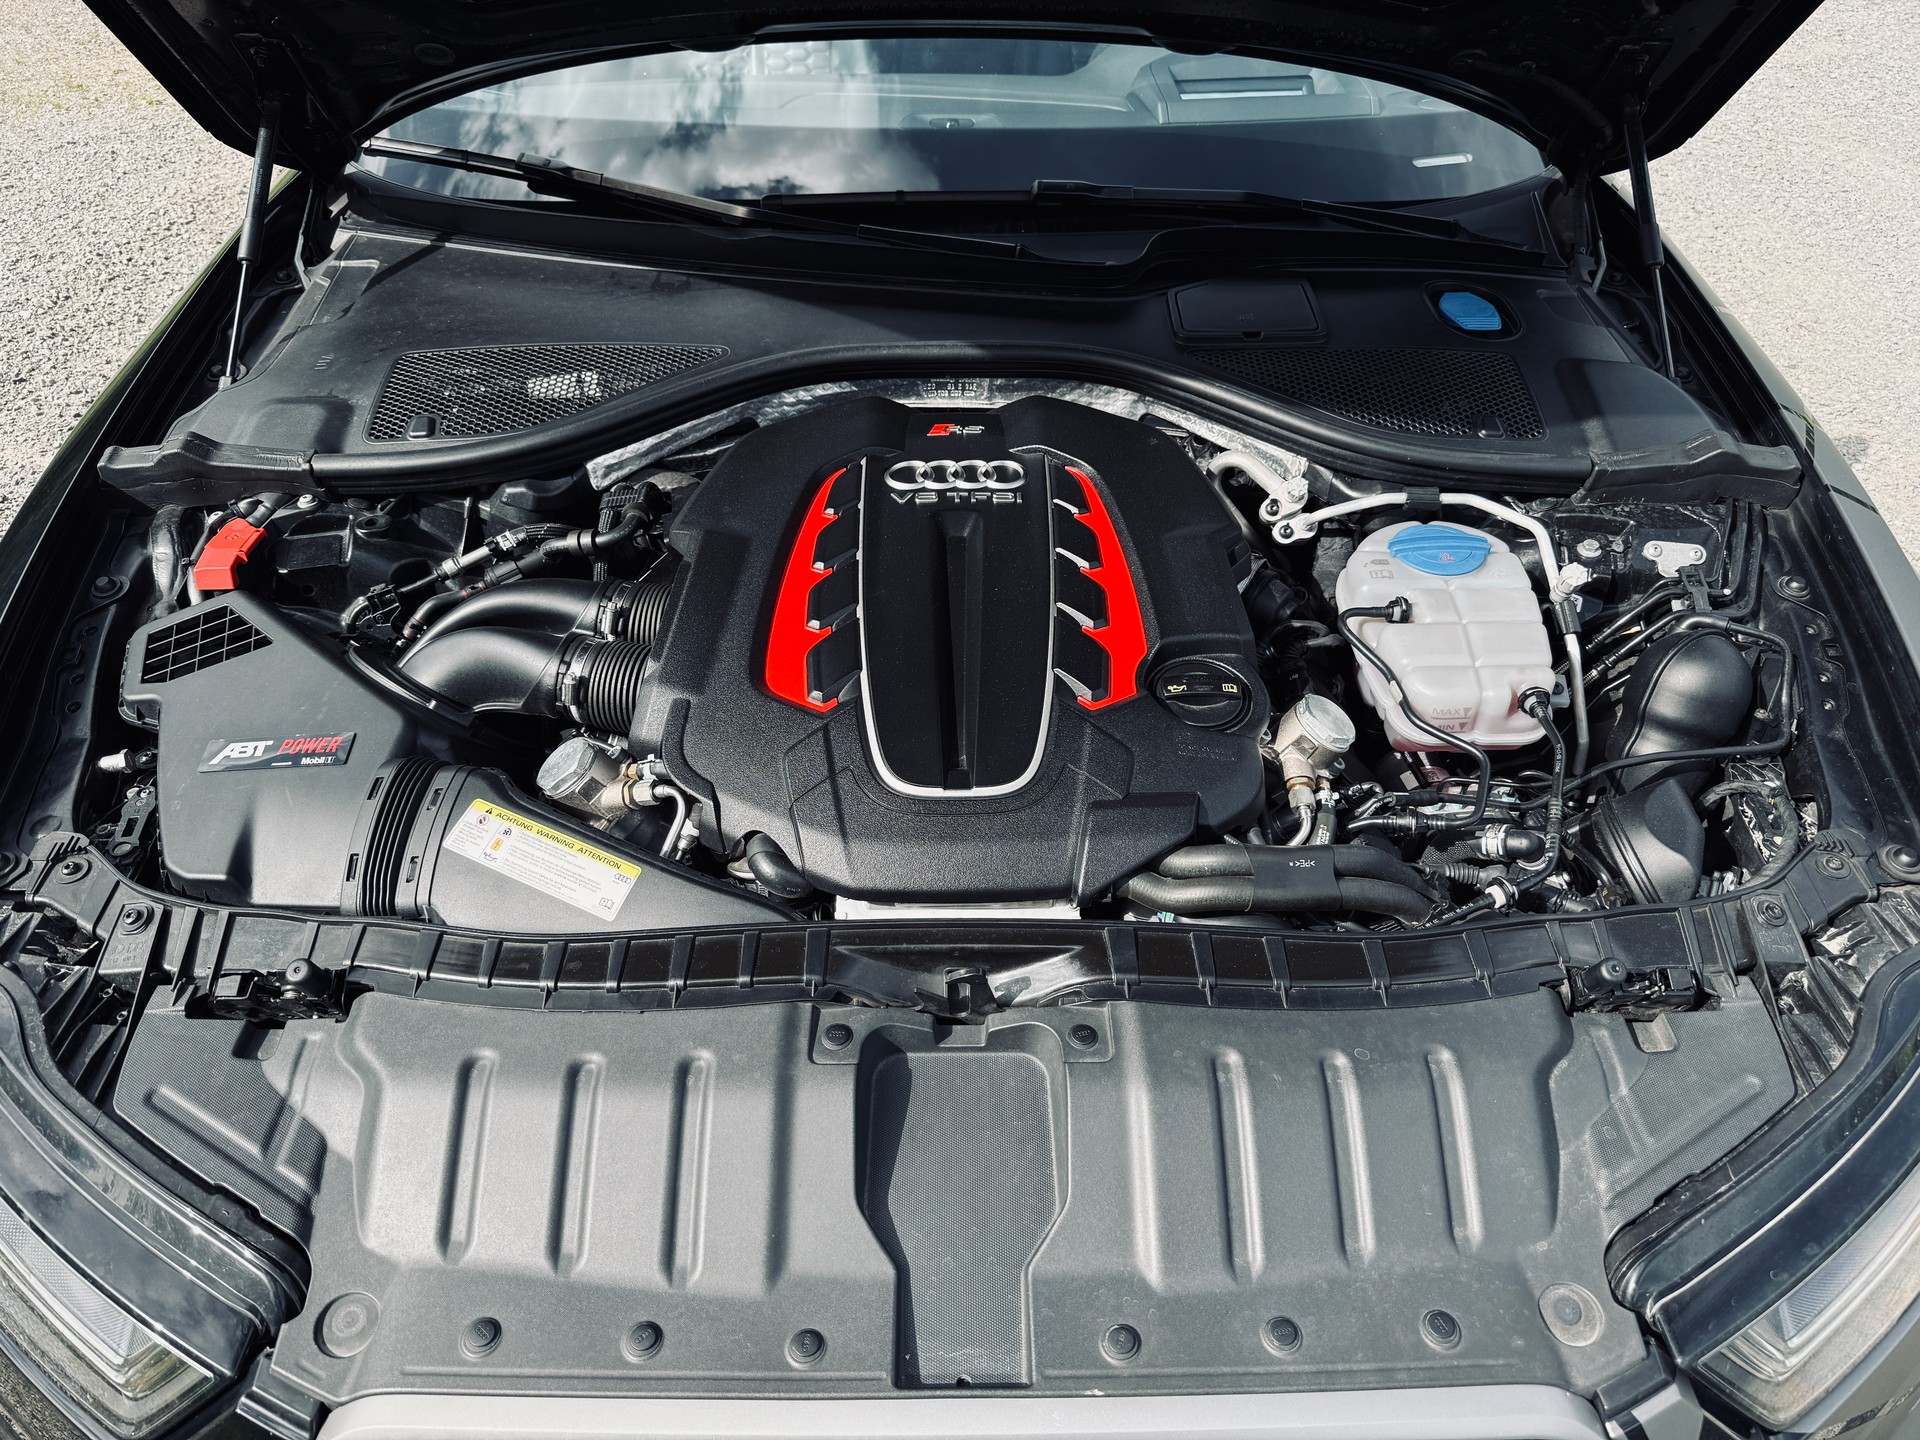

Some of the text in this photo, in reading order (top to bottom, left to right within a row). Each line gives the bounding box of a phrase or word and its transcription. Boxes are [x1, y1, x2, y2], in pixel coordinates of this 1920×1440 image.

[890, 491, 1023, 504] V8 TFSI
[208, 736, 343, 765] ABT POWER
[301, 757, 324, 765] Mobil
[495, 812, 533, 832] ACHTUNG
[536, 828, 575, 850] WARNING
[577, 846, 622, 870] ATTENTION
